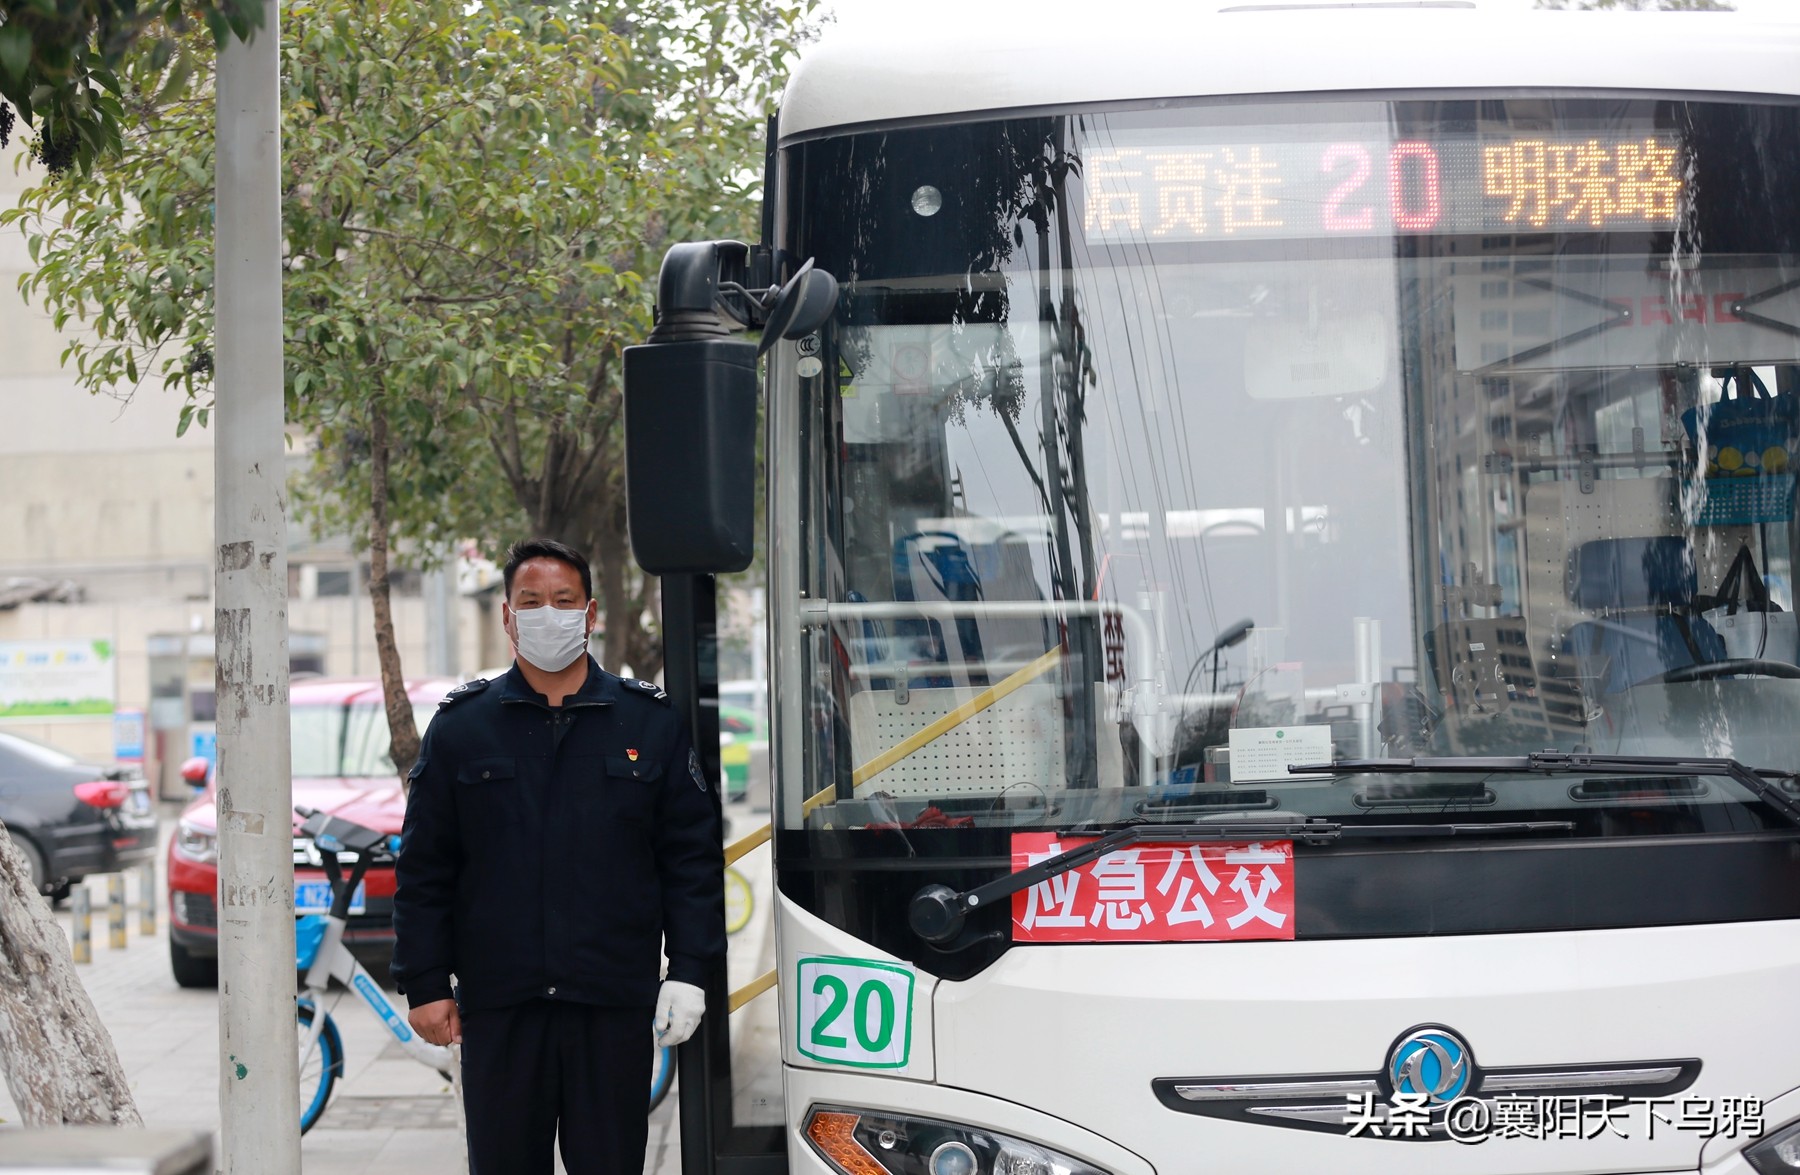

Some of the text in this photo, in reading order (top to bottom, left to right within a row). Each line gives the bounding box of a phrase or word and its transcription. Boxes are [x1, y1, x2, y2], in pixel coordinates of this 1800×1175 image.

[1084, 139, 1682, 234] 后贾洼 20 明珠路
[1020, 842, 1288, 931] 应急公交
[810, 974, 895, 1053] 20
